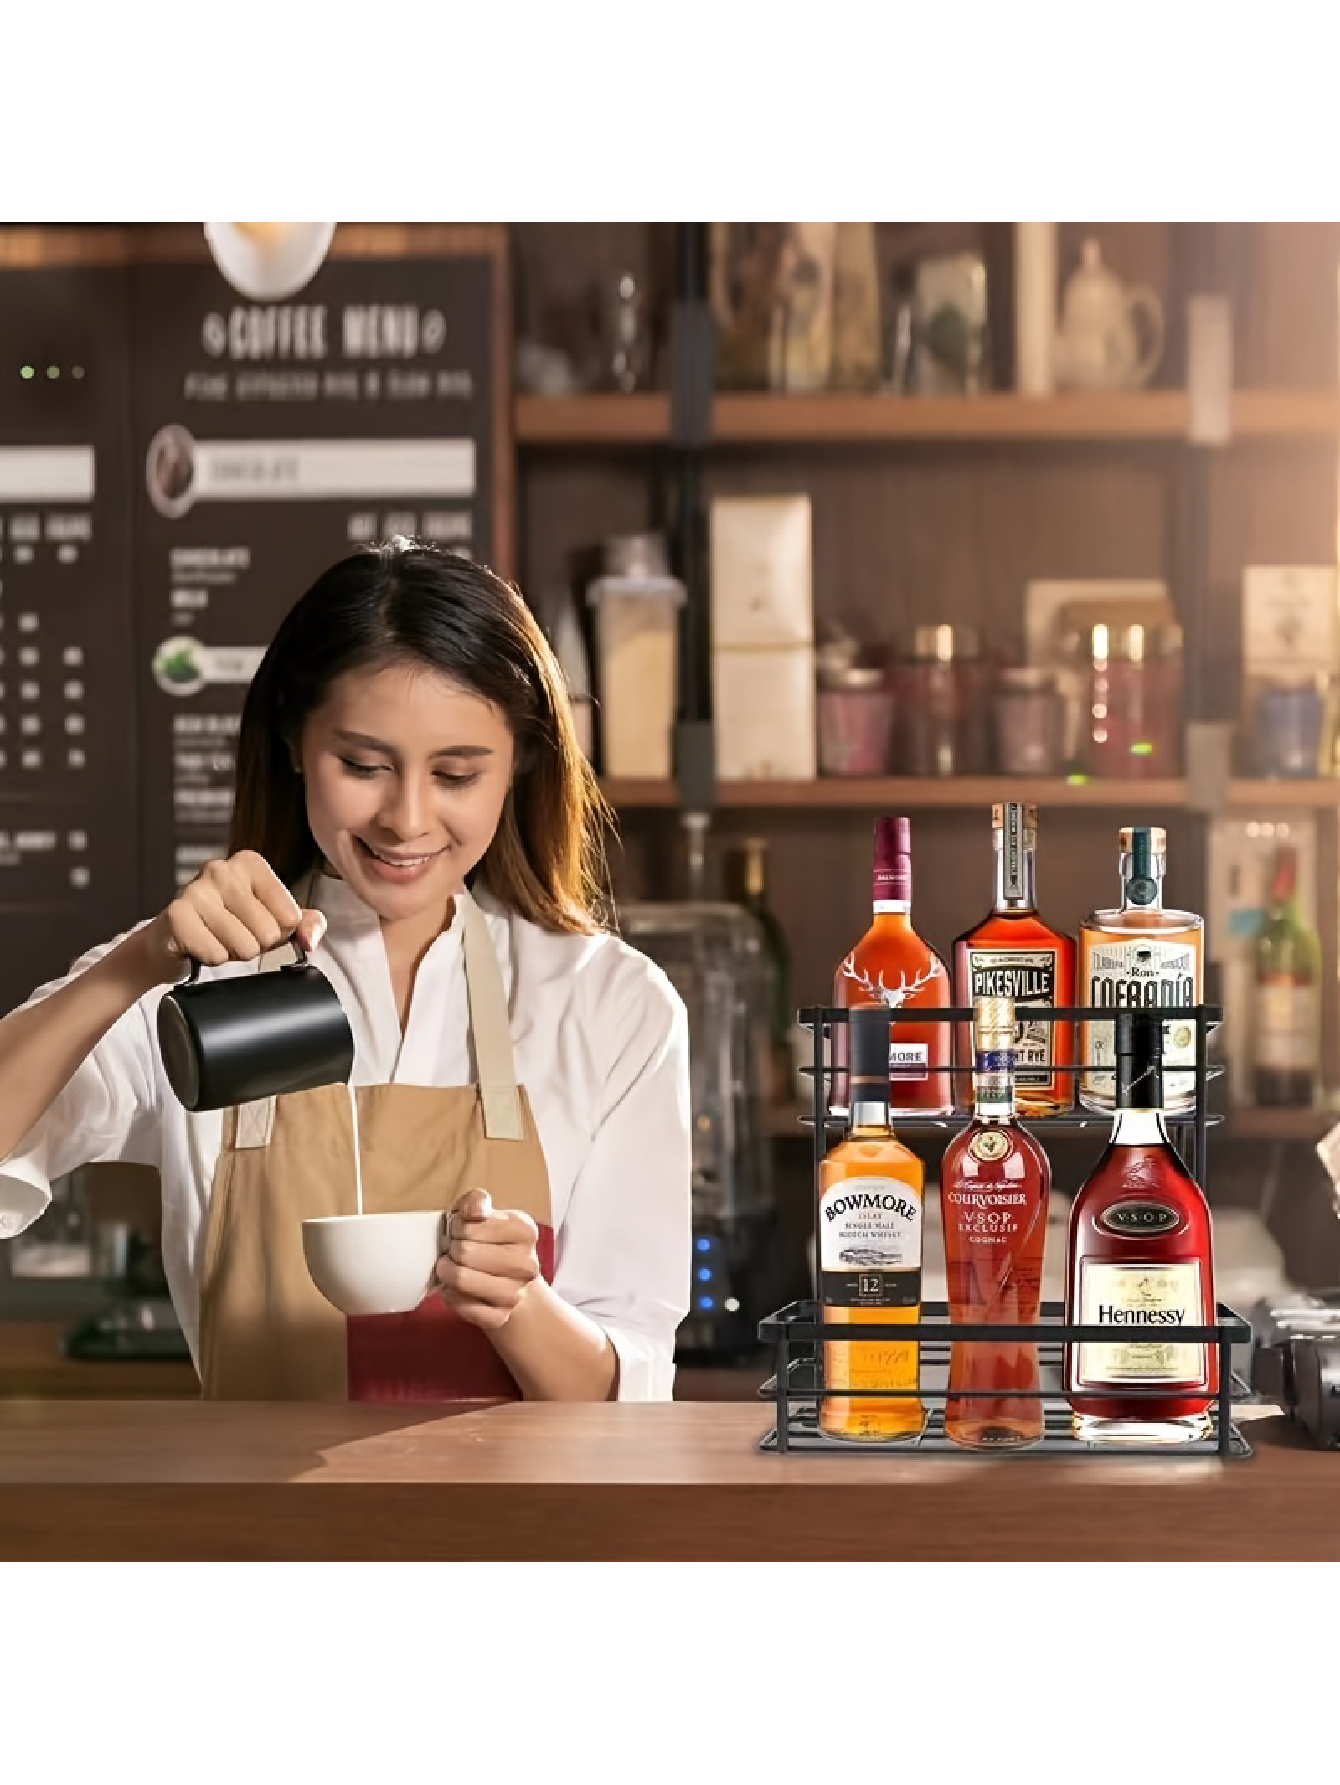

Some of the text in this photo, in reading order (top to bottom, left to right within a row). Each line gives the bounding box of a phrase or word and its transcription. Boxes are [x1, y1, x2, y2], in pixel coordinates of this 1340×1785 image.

[229, 304, 328, 359] COFFEE
[1131, 966, 1155, 977] Ron
[974, 970, 1051, 996] PIKESVILLE
[825, 1193, 917, 1222] BOWMORE
[947, 1191, 1028, 1209] COURVOISIER
[863, 1278, 879, 1292] 12
[1098, 1304, 1185, 1326] Hennessy
